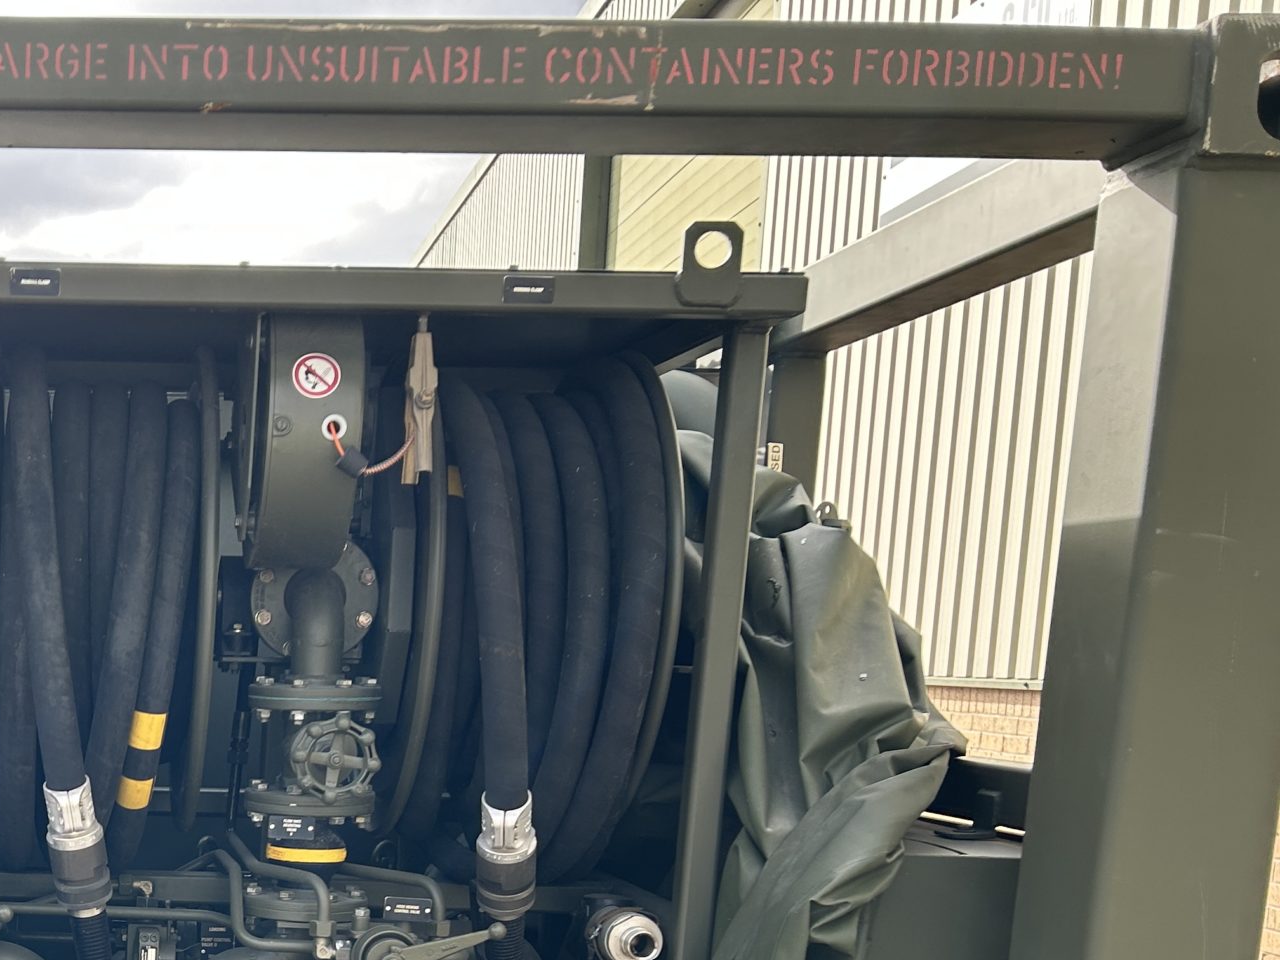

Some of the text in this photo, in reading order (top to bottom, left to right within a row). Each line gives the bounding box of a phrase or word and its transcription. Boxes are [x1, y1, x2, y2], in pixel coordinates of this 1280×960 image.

[128, 43, 229, 81] INTO
[247, 45, 524, 84] UNSUITABLE
[545, 47, 835, 87] CONTAINERS
[852, 48, 1123, 90] FORBIDDEN!
